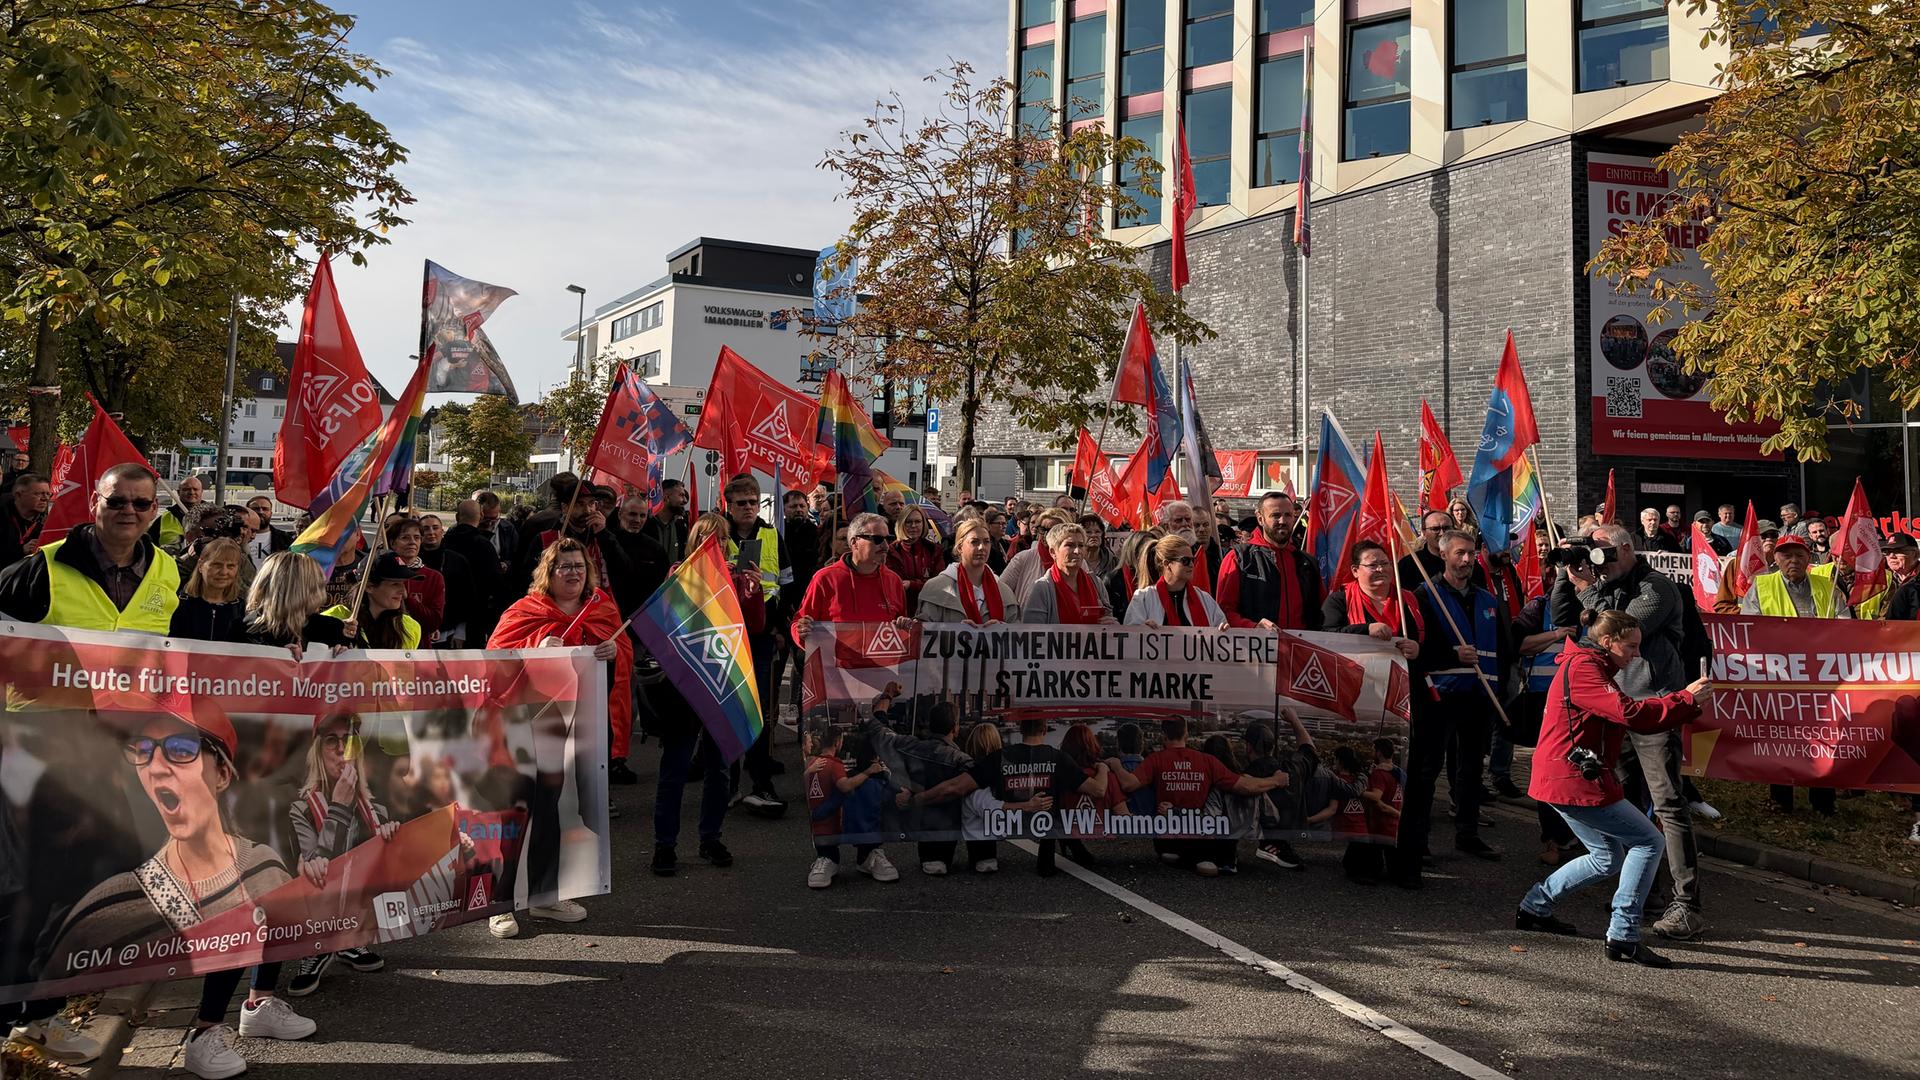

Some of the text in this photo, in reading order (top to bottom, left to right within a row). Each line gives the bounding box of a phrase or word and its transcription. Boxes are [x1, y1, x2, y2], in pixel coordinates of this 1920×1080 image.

[1606, 167, 1641, 181] EINTRITT
[1607, 189, 1630, 216] IG
[704, 305, 764, 318] VOLKSWAGEN
[704, 316, 764, 329] IMMOBILIEN
[930, 411, 937, 430] P
[1612, 429, 1773, 444] Wir feiern gemeinsam im Allerpark Wolfsbur
[599, 439, 631, 460] AKTIV
[743, 438, 810, 486] OLFSBURG
[1642, 555, 1693, 569] MMEN
[1703, 622, 1754, 650] INT
[923, 629, 1279, 664] ZUSAMMENHALT IST UNSERE
[1708, 653, 1809, 681] NSERE
[52, 662, 491, 704] Heute füreinander. Morgen miteinander.
[995, 662, 1214, 700] STÄRKSTE MARKE
[1712, 688, 1852, 722] KÄMPFEN
[1735, 725, 1885, 742] ALLE BELEGSCHAFTEN
[1753, 743, 1868, 759] IM VW-KONZERN
[1002, 761, 1056, 776] SOLIDARITÄT
[1174, 761, 1192, 771] WIR
[1007, 777, 1049, 789] GEWINNT
[1161, 771, 1205, 782] GESTALTEN
[1165, 781, 1201, 792] ZUKUNFT
[984, 807, 1230, 838] IGM @ VW Immobilien
[386, 901, 407, 919] BR
[412, 898, 462, 917] BETRIEBSRAT
[66, 914, 359, 971] IGM @ Volkswagen Group Services
